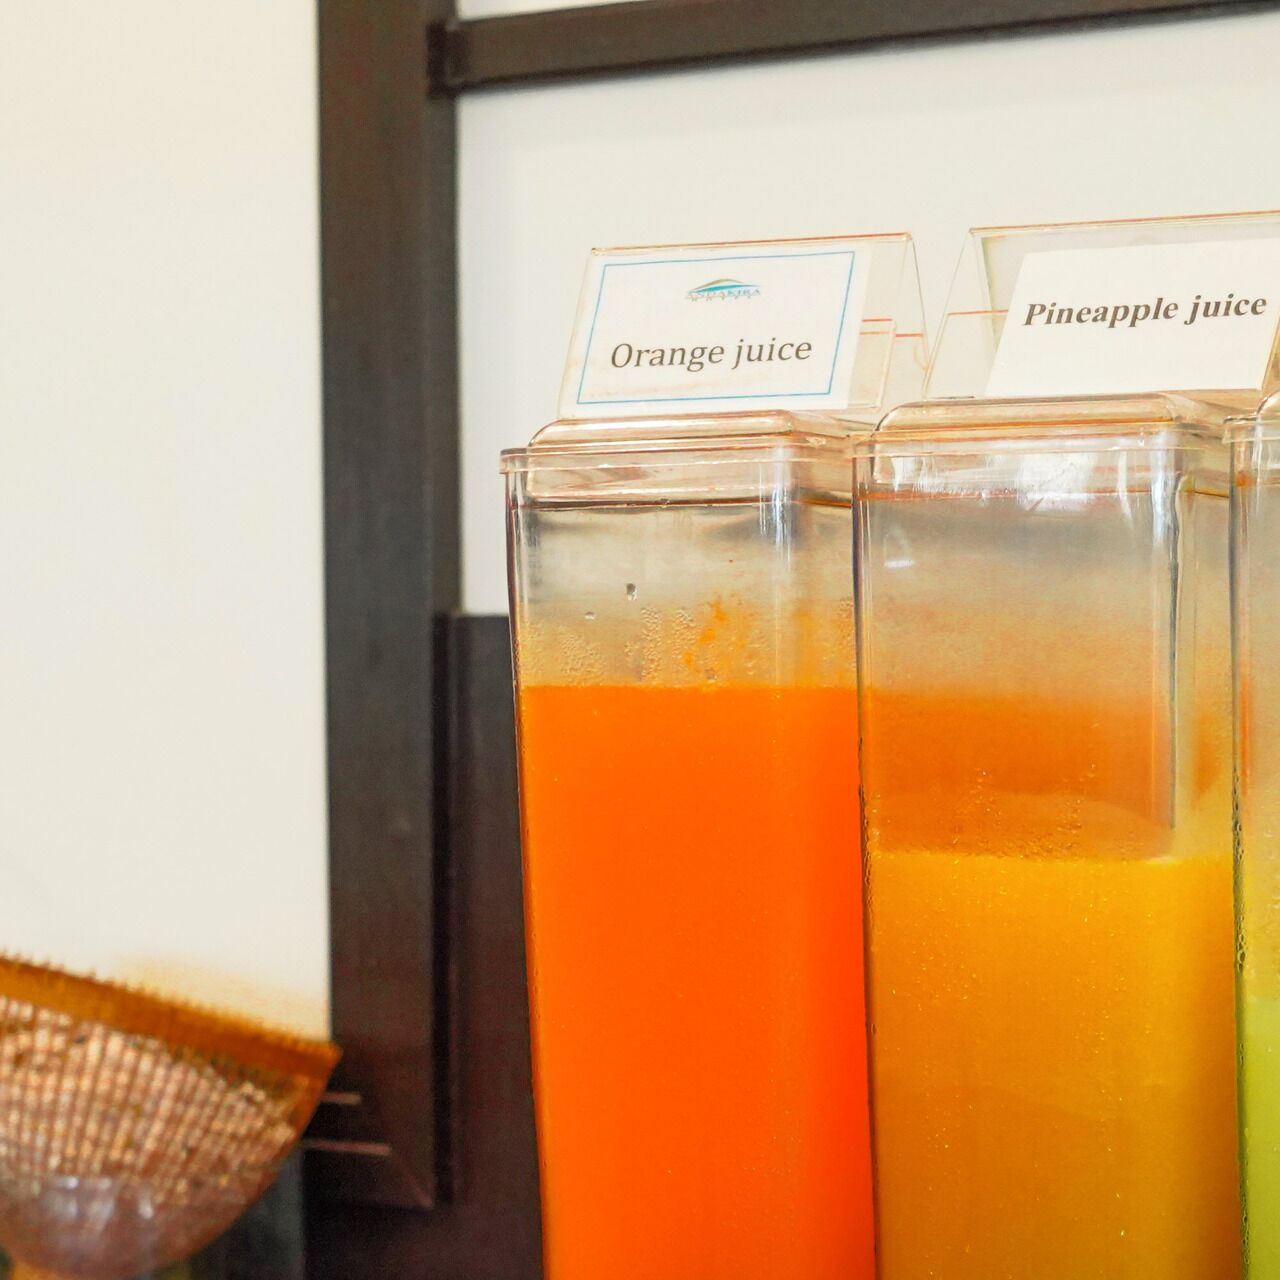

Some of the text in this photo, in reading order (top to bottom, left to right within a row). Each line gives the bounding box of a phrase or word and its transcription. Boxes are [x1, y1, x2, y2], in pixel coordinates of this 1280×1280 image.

[1022, 293, 1267, 328] Pineapple juice
[610, 337, 812, 372] Orange juice
